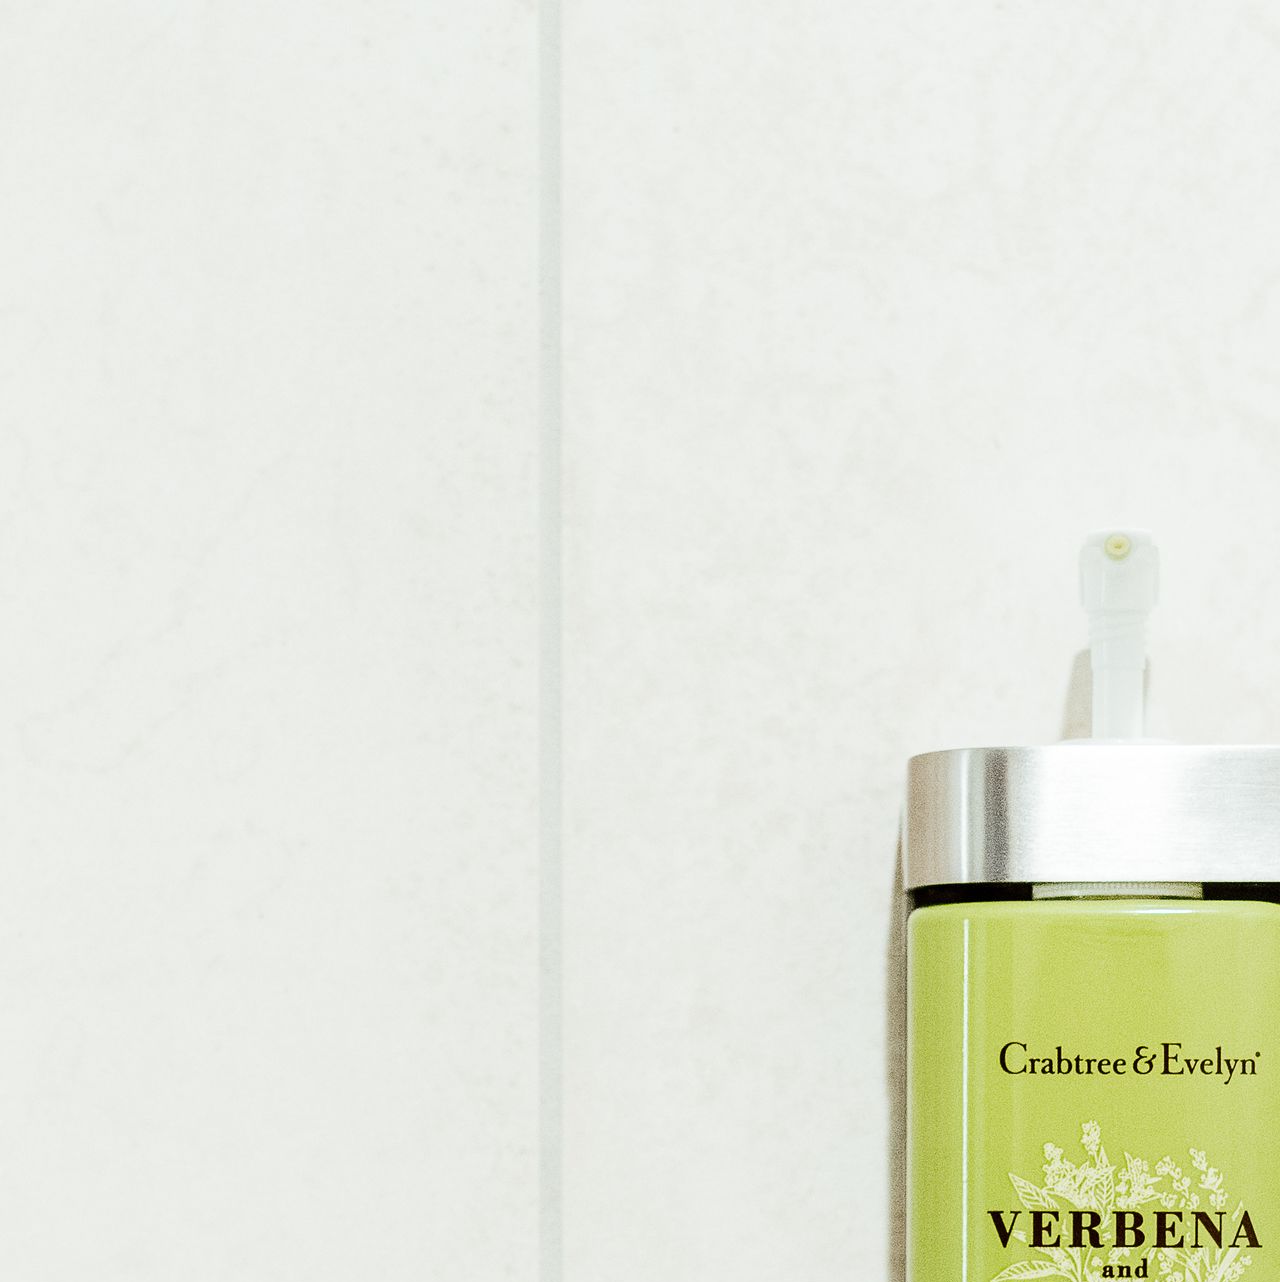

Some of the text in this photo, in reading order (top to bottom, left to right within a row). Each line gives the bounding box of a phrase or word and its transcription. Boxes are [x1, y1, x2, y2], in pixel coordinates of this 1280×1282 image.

[999, 1041, 1127, 1075] Crabtree
[1132, 1045, 1157, 1075] &
[986, 1210, 1263, 1249] VERBENA
[1101, 1257, 1149, 1279] and
